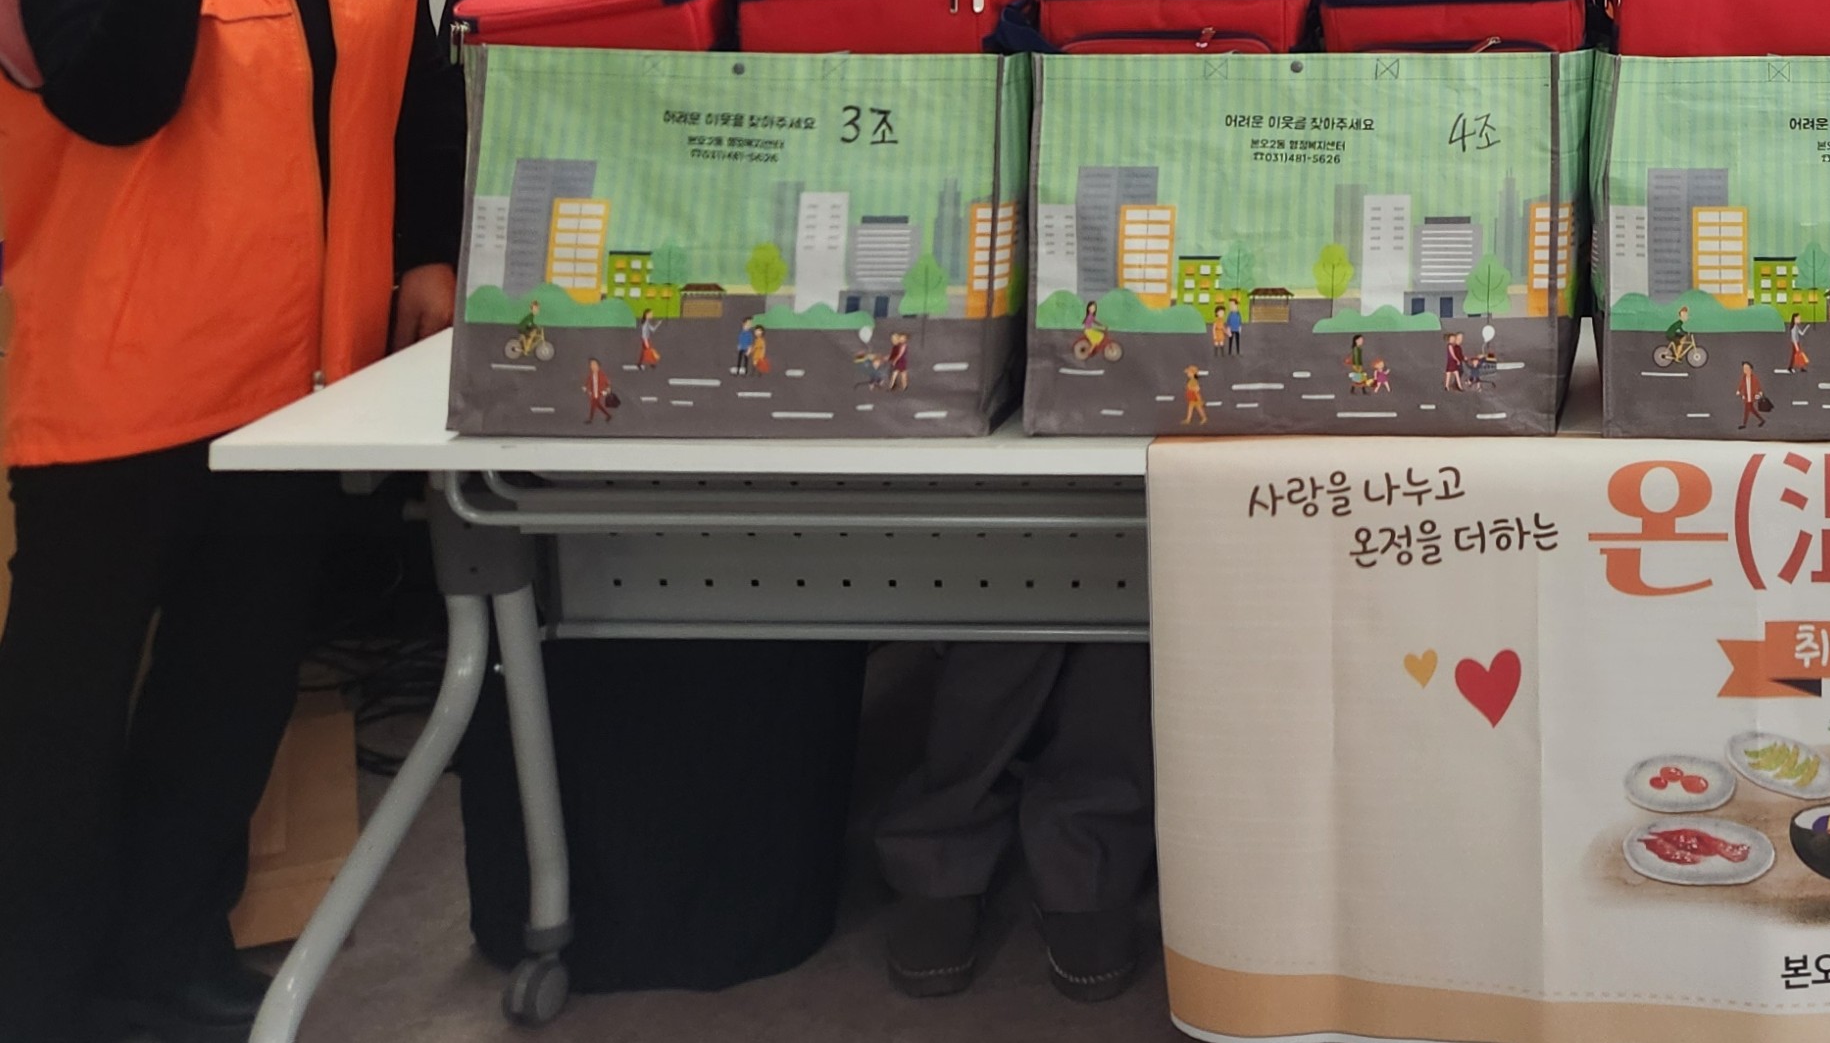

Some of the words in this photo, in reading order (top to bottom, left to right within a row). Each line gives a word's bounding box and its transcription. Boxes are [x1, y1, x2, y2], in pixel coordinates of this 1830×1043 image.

[663, 109, 700, 126] 어려운
[705, 112, 744, 128] 이웃을
[748, 114, 817, 130] 찾아주세요
[840, 104, 898, 145] 3조
[1224, 113, 1264, 129] 어려운
[1268, 115, 1306, 131] 이웃을
[1310, 117, 1375, 132] 찾아주세요
[1448, 112, 1501, 153] 4조
[1789, 117, 1829, 132] 어려운
[1250, 137, 1286, 150] 본오2동
[1289, 139, 1346, 152] 행정복지센터
[1247, 470, 1352, 518] 사랑을
[1363, 466, 1466, 507] 나누고
[1349, 519, 1443, 568] 온정을
[1453, 512, 1559, 555] 더하는
